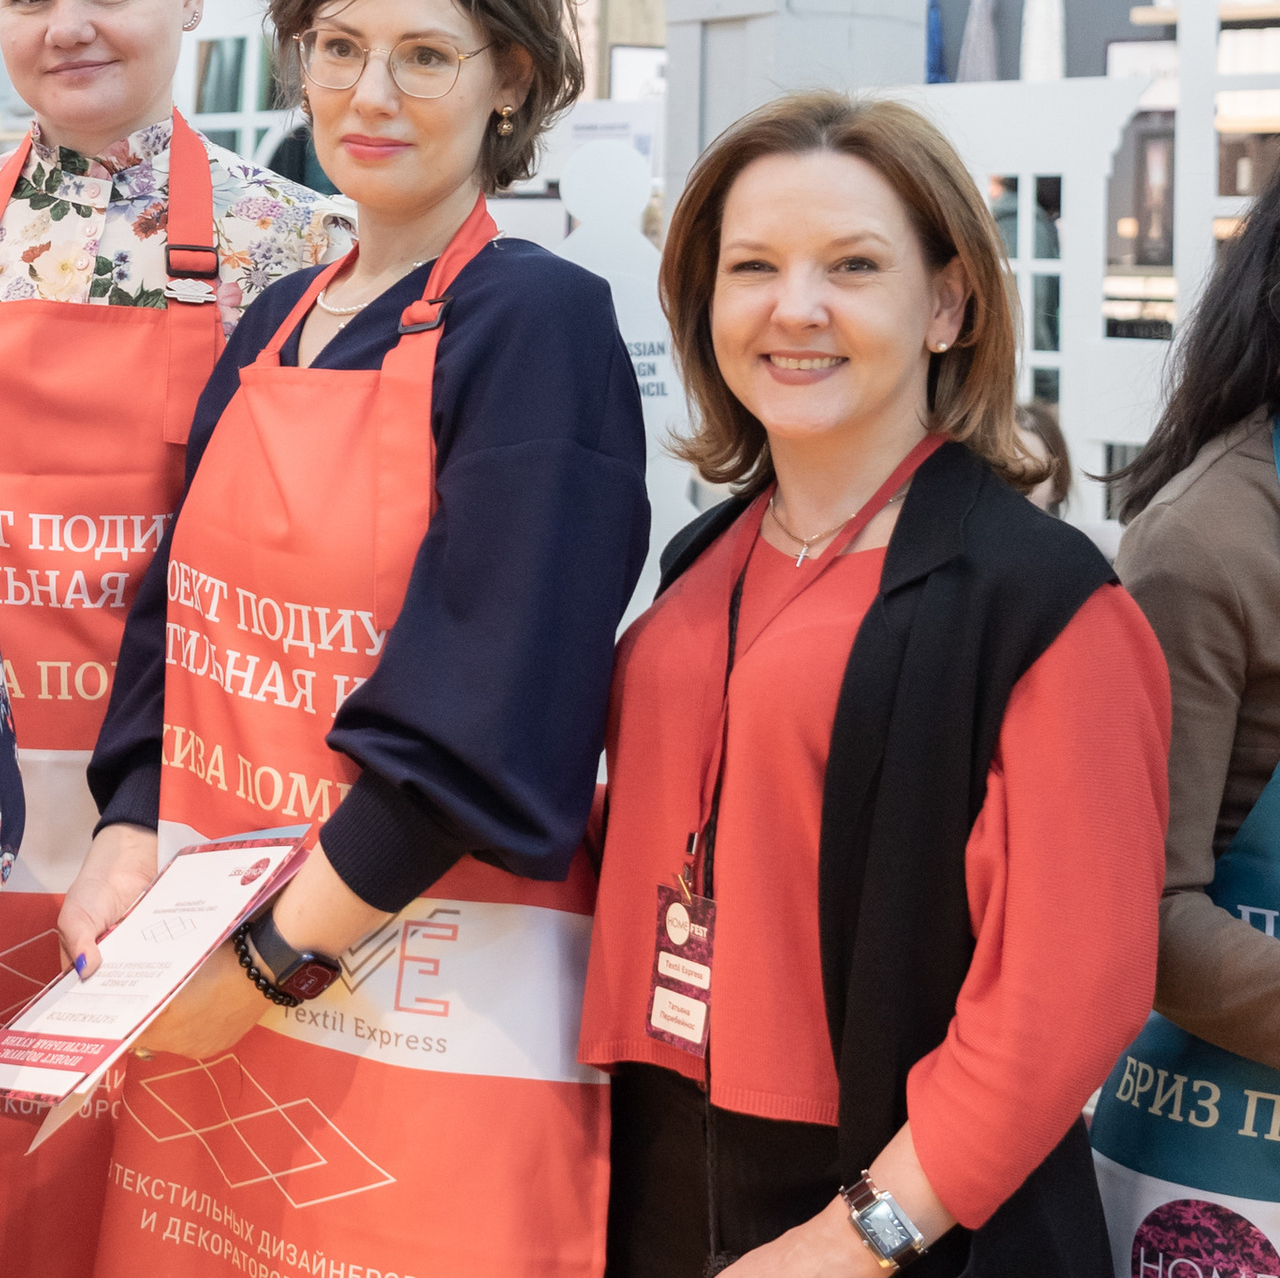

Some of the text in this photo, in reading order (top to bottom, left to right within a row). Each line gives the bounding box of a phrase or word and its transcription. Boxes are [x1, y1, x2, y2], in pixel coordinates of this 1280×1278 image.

[28, 513, 173, 561] ПОДИ
[236, 754, 353, 823] ПОМ
[354, 1017, 448, 1053] Express
[1116, 1055, 1222, 1128] БРИЗ
[113, 1162, 254, 1246] ТЕКСТИЛЬНЫХ
[140, 1208, 158, 1230] И
